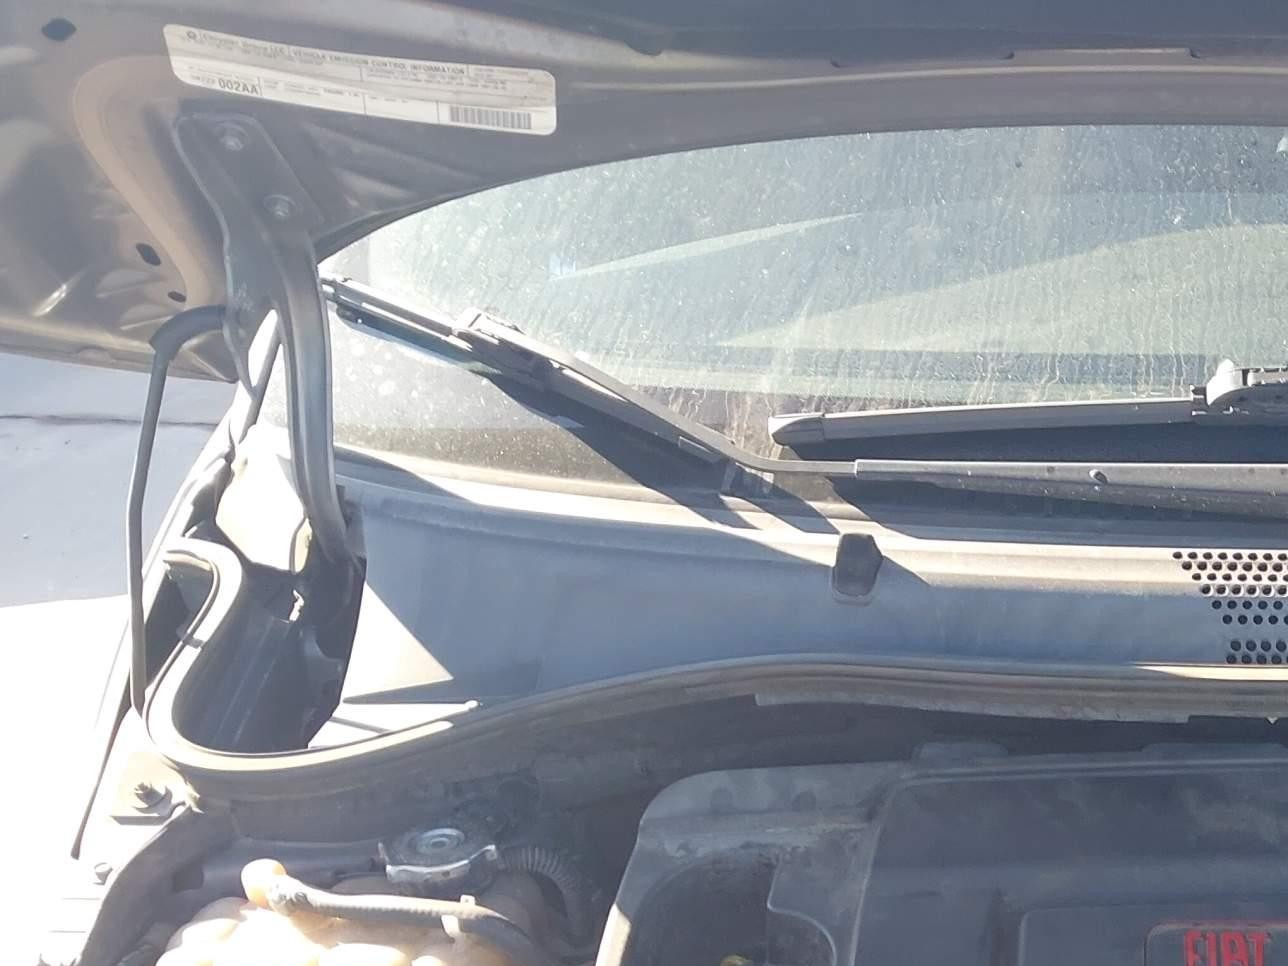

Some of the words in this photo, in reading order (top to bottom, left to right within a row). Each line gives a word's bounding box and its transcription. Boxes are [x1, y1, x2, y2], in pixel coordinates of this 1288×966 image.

[371, 58, 406, 70] CONTROL
[409, 62, 465, 75] INFORMATION
[218, 79, 259, 95] 002AA
